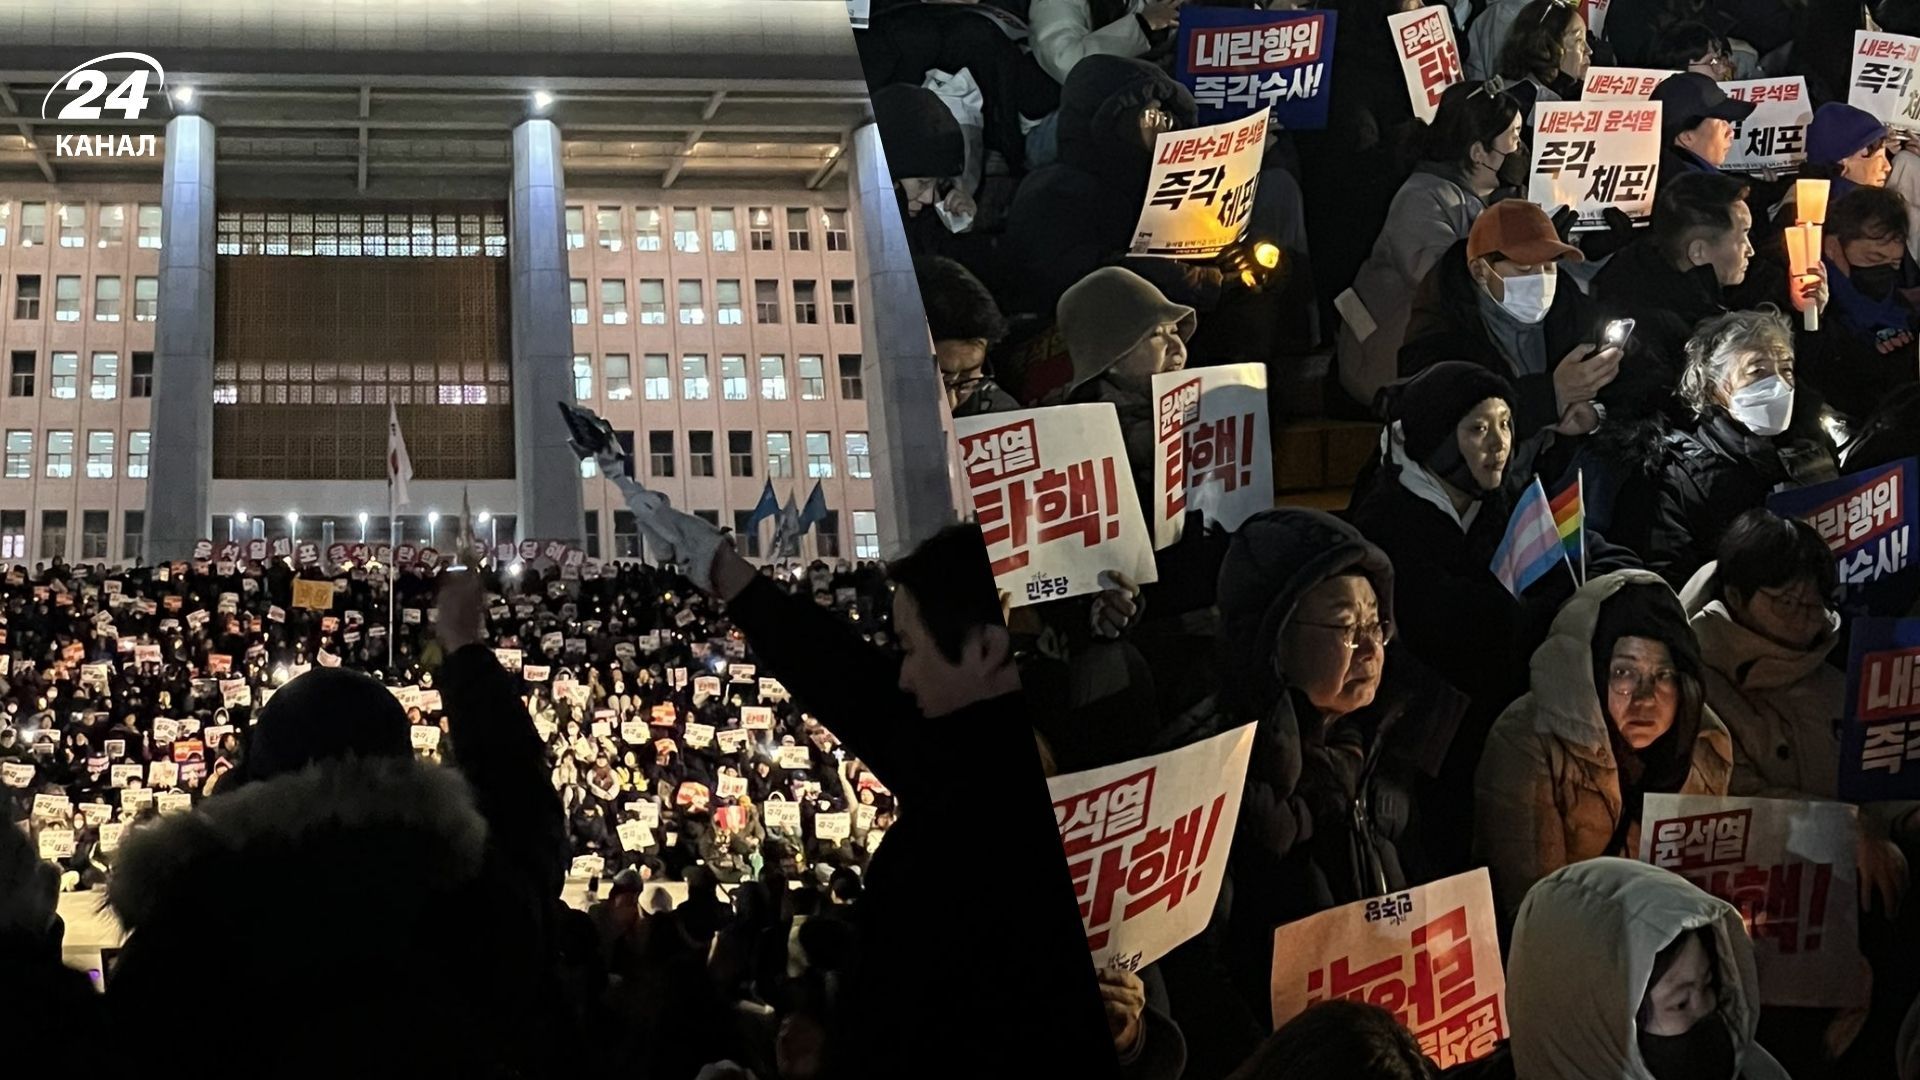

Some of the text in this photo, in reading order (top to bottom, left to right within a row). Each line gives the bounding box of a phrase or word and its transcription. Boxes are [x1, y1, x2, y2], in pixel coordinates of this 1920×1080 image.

[1195, 21, 1319, 67] 내란행위
[1403, 15, 1444, 54] 윤석열
[1858, 38, 1920, 64] 내란수괴
[1194, 63, 1323, 110] 즉각수사!
[1586, 75, 1638, 96] 내란수괴
[1750, 82, 1800, 104] 윤석열
[1855, 62, 1914, 97] 즉각
[1538, 110, 1657, 133] 내란수괴 윤석열
[1745, 125, 1806, 157] 체포
[1157, 131, 1235, 165] 내란수괴
[1535, 141, 1597, 179] 즉각
[1150, 165, 1227, 211] 즉각
[1584, 164, 1656, 203] 체포!
[1161, 383, 1200, 437] 윤석열
[962, 425, 1035, 477] 석열
[1166, 413, 1255, 521] 탄핵!
[973, 456, 1120, 577] 탄핵!
[1806, 475, 1898, 551] 란행위
[1026, 576, 1069, 601] 민주당
[1656, 815, 1746, 869] 윤석열
[1067, 792, 1227, 952] 탄핵!
[1364, 893, 1413, 922] 민주당
